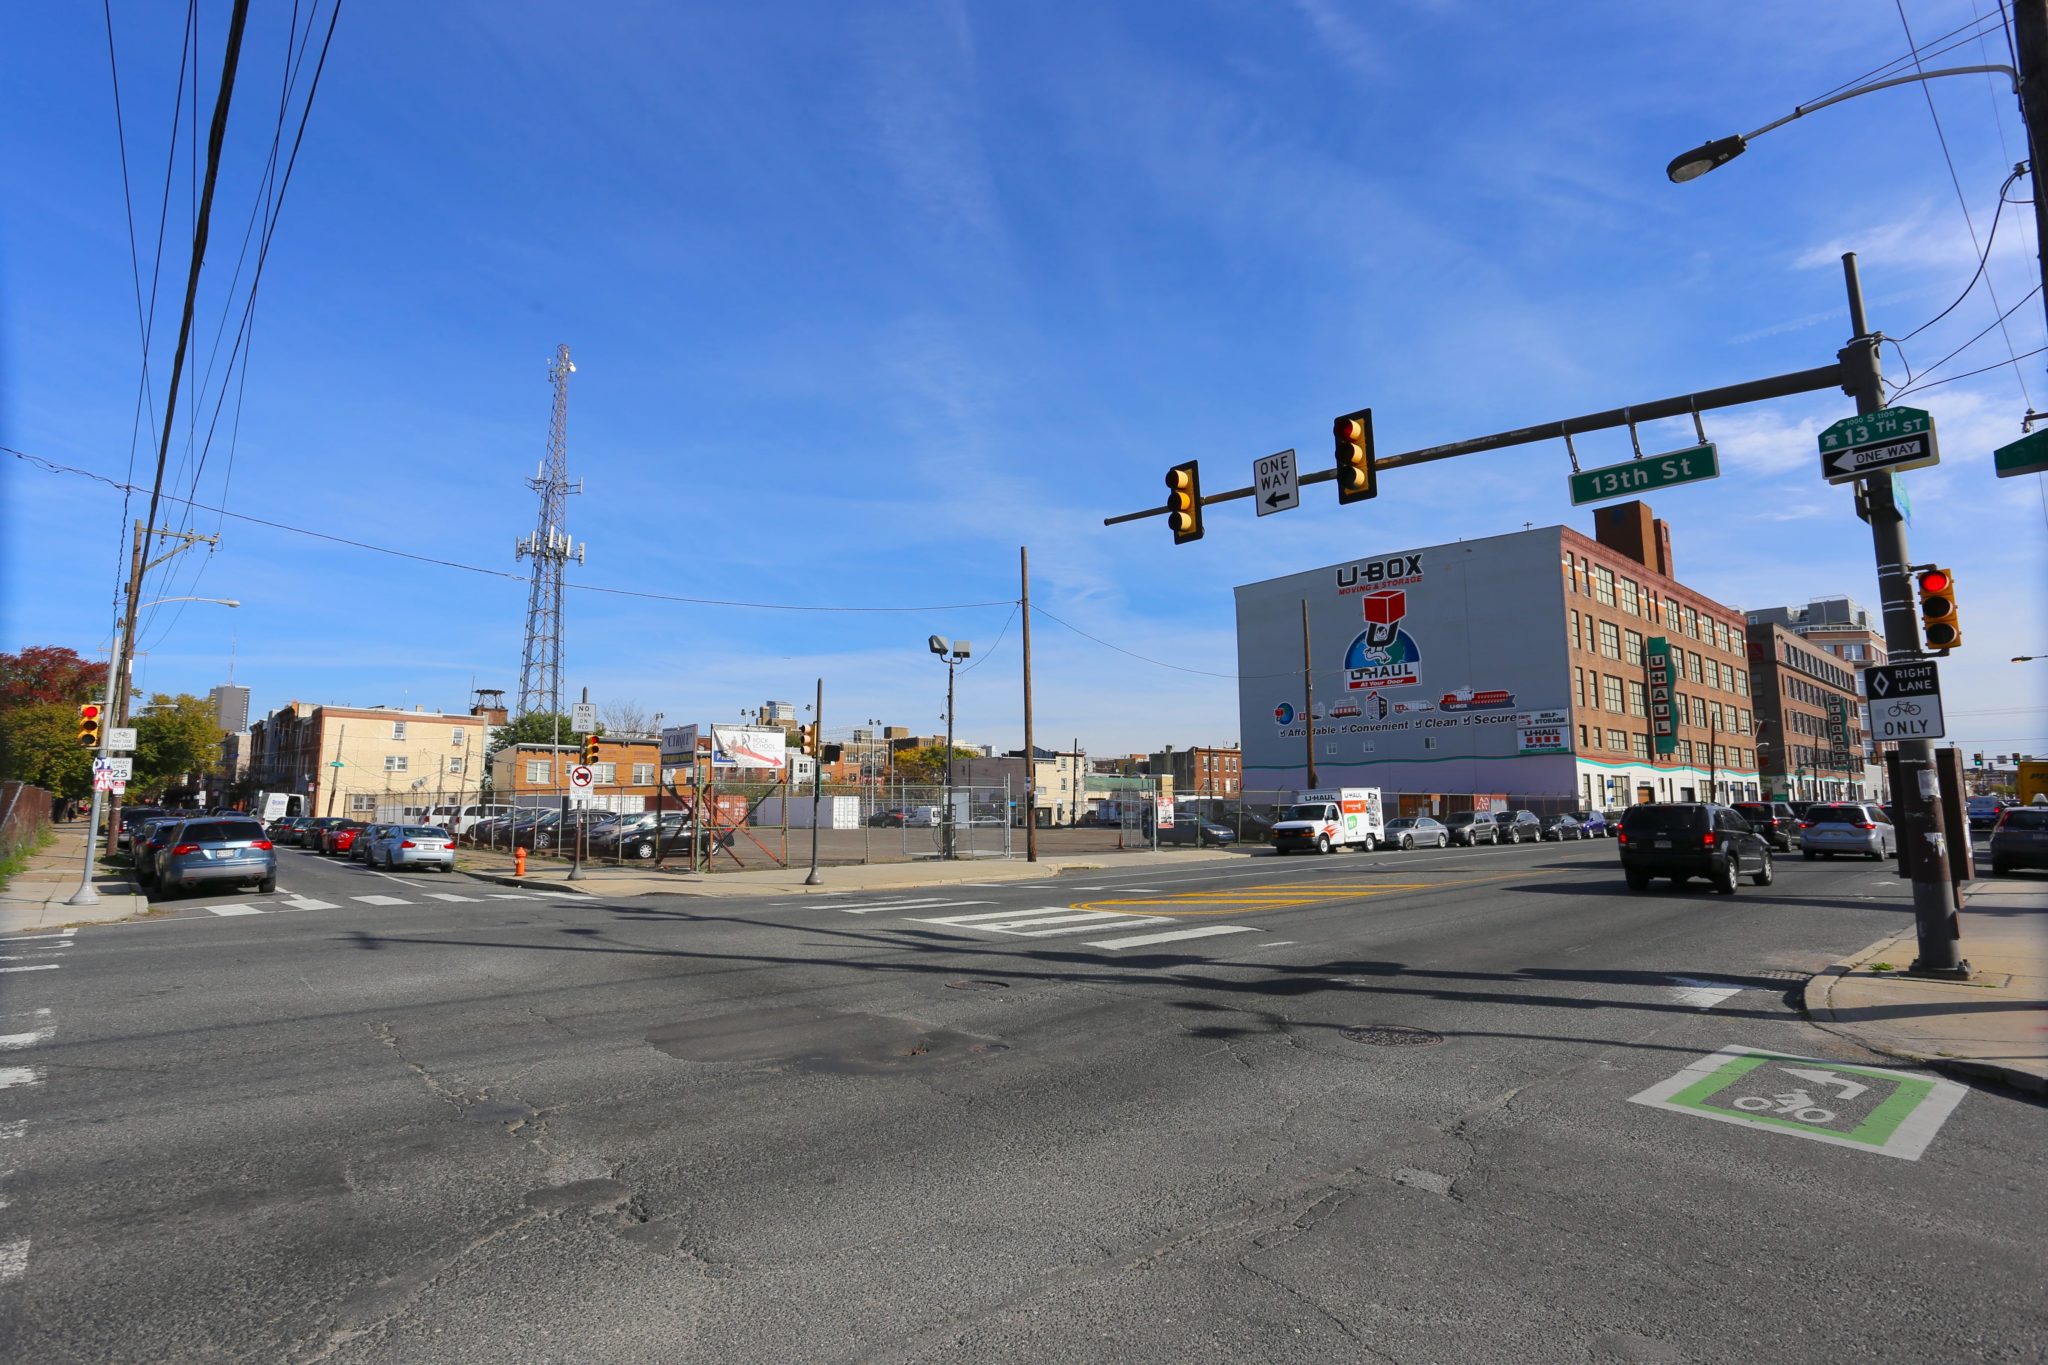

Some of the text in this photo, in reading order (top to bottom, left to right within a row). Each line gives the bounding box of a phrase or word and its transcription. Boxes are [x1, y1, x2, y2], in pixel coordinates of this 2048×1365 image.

[1867, 414, 1875, 422] S
[1877, 411, 1895, 419] 1100
[1845, 418, 1922, 444] 13 TH ST
[1856, 442, 1916, 464] ONE WAY
[1261, 456, 1289, 475] ONE
[1261, 470, 1289, 490] WAY
[1592, 458, 1692, 494] 13th St
[1336, 553, 1424, 588] U-BOX
[1339, 584, 1372, 595] MOVING
[1382, 575, 1424, 588] STORAGE
[1895, 667, 1932, 679] RIGHT
[1898, 680, 1932, 692] LANE
[1288, 726, 1336, 737] Affodable
[1350, 721, 1409, 734] Convenient
[1425, 717, 1458, 728] Clean
[1474, 714, 1517, 725] Secure
[1884, 720, 1928, 735] ONLY
